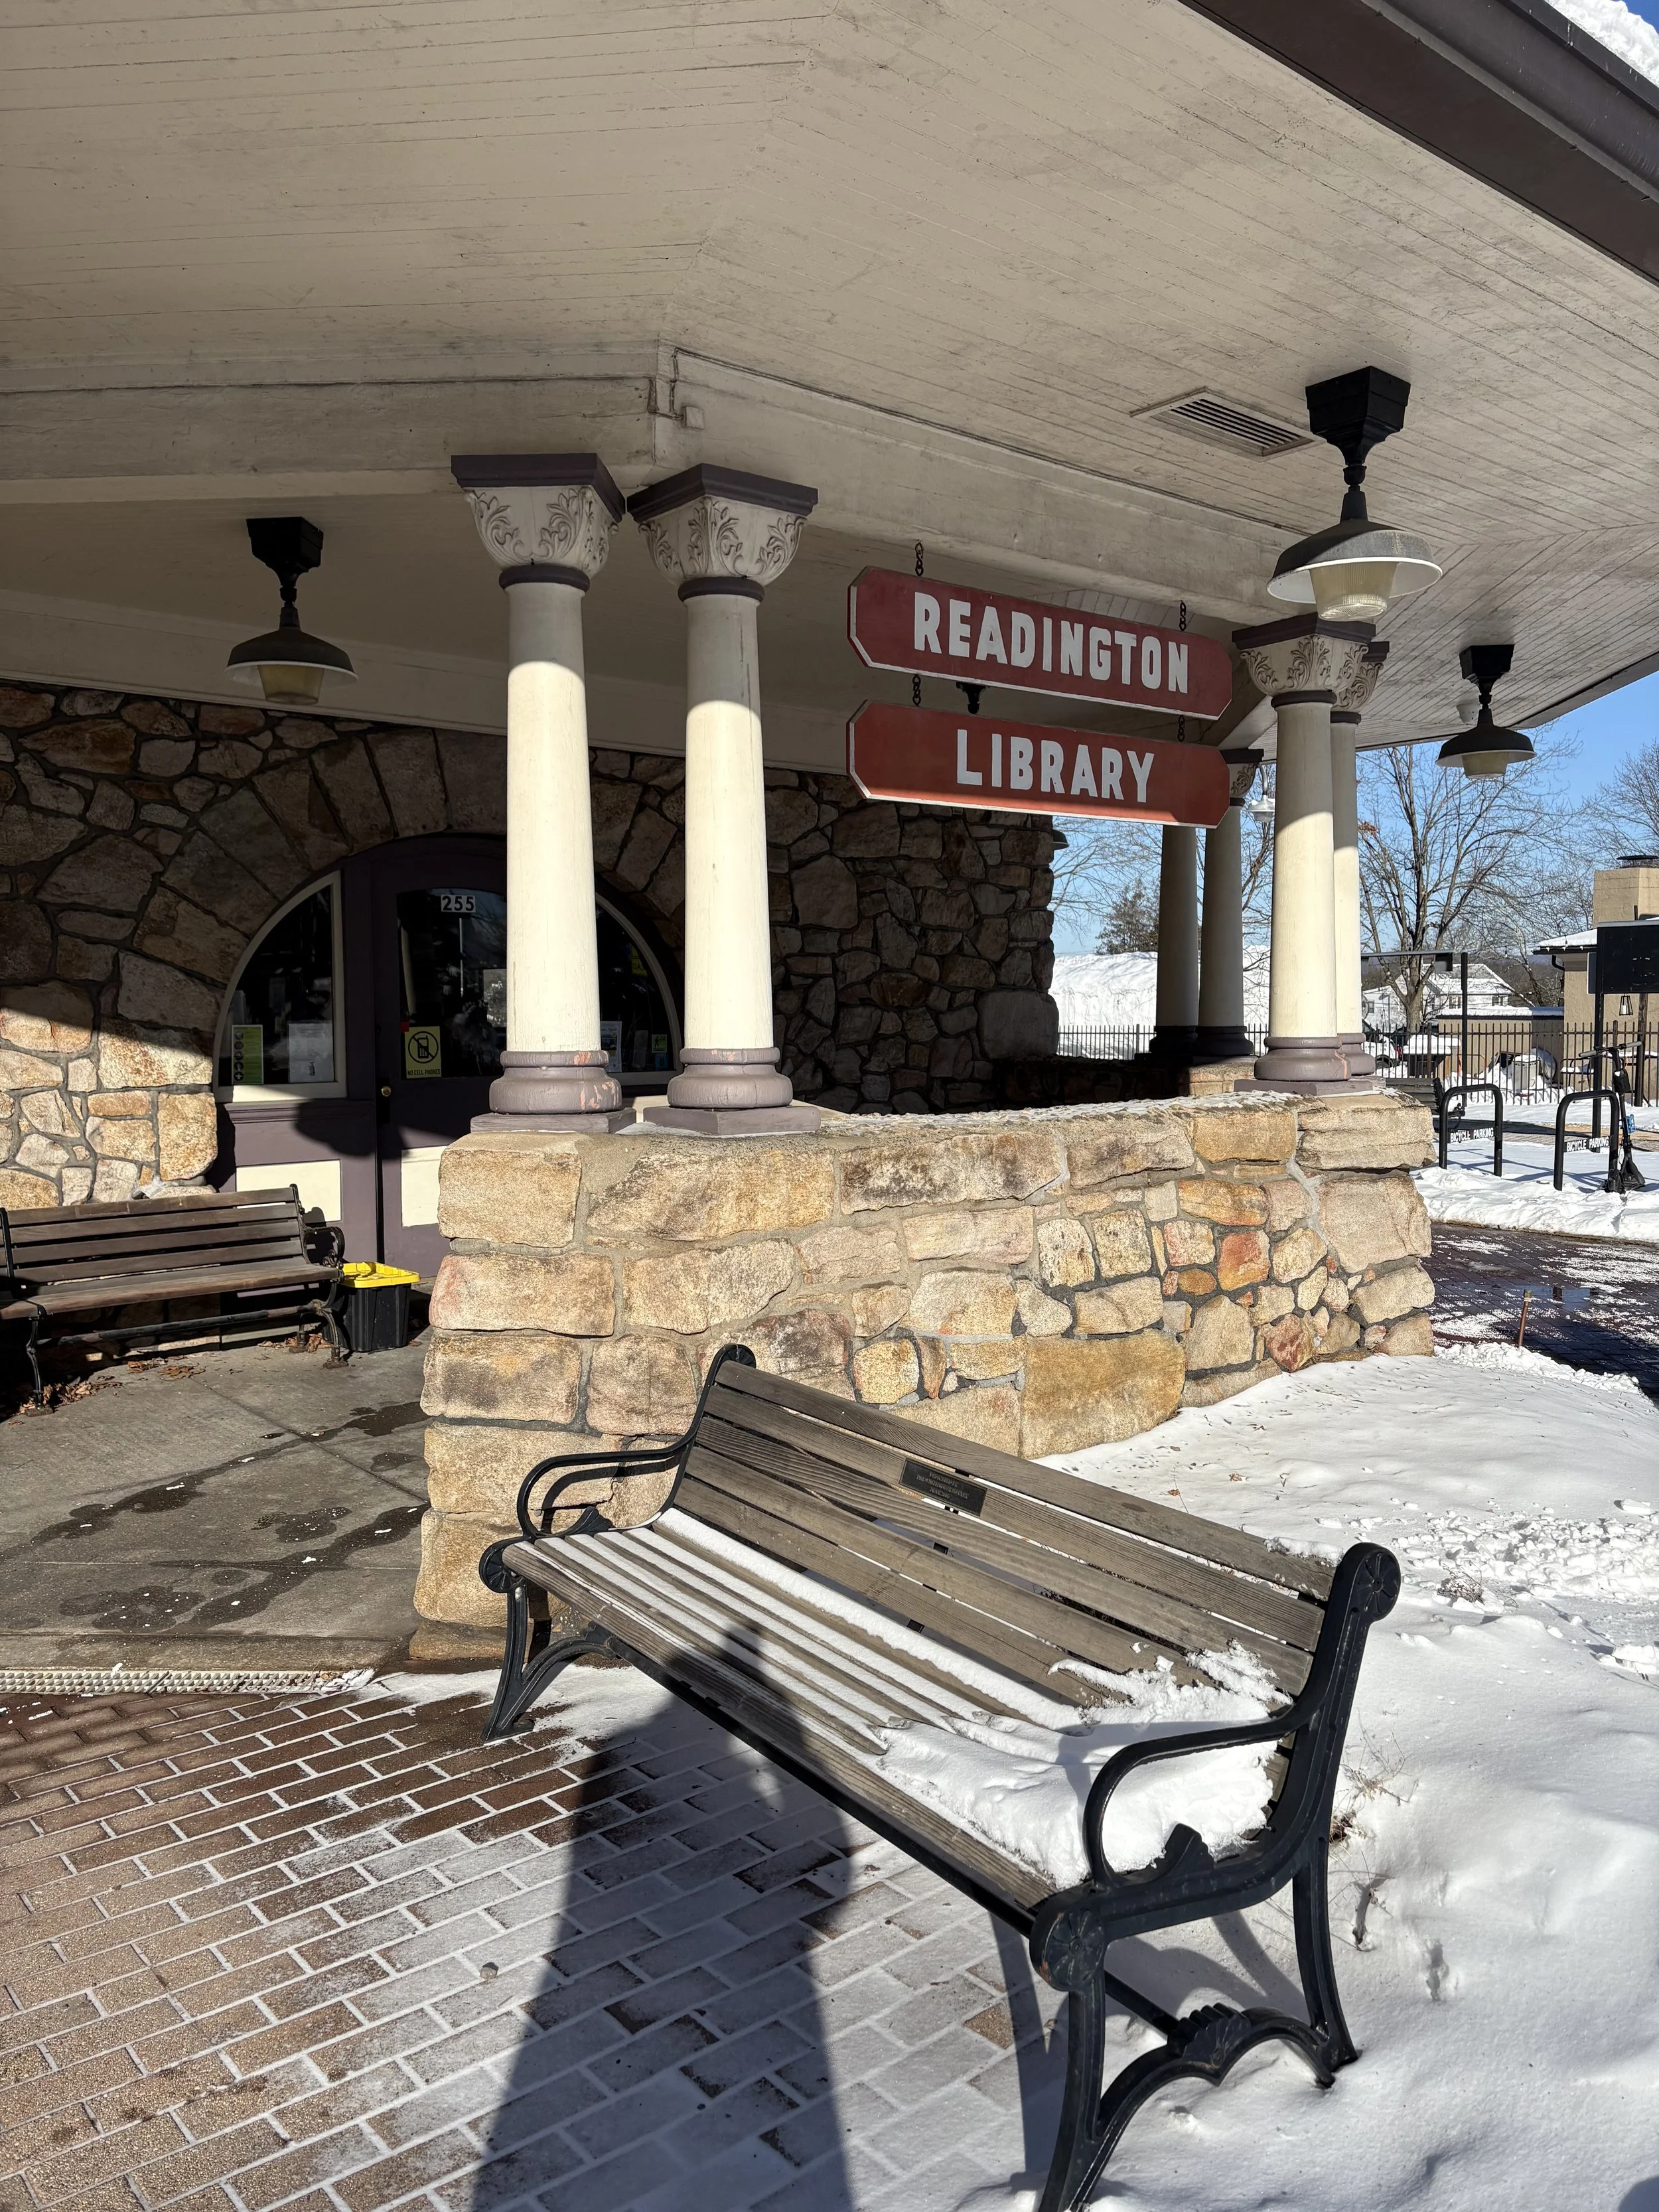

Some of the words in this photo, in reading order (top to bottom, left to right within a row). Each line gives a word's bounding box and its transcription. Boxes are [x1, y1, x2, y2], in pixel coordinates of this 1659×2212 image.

[914, 592, 1189, 694] READINGTON
[956, 729, 1155, 803] LIBRARY
[442, 895, 474, 911] 255
[1450, 1130, 1471, 1143] BICYCLE
[1473, 1127, 1494, 1140] PARKING
[1566, 1139, 1587, 1152] BICYCLE
[1589, 1136, 1609, 1149] PARKING
